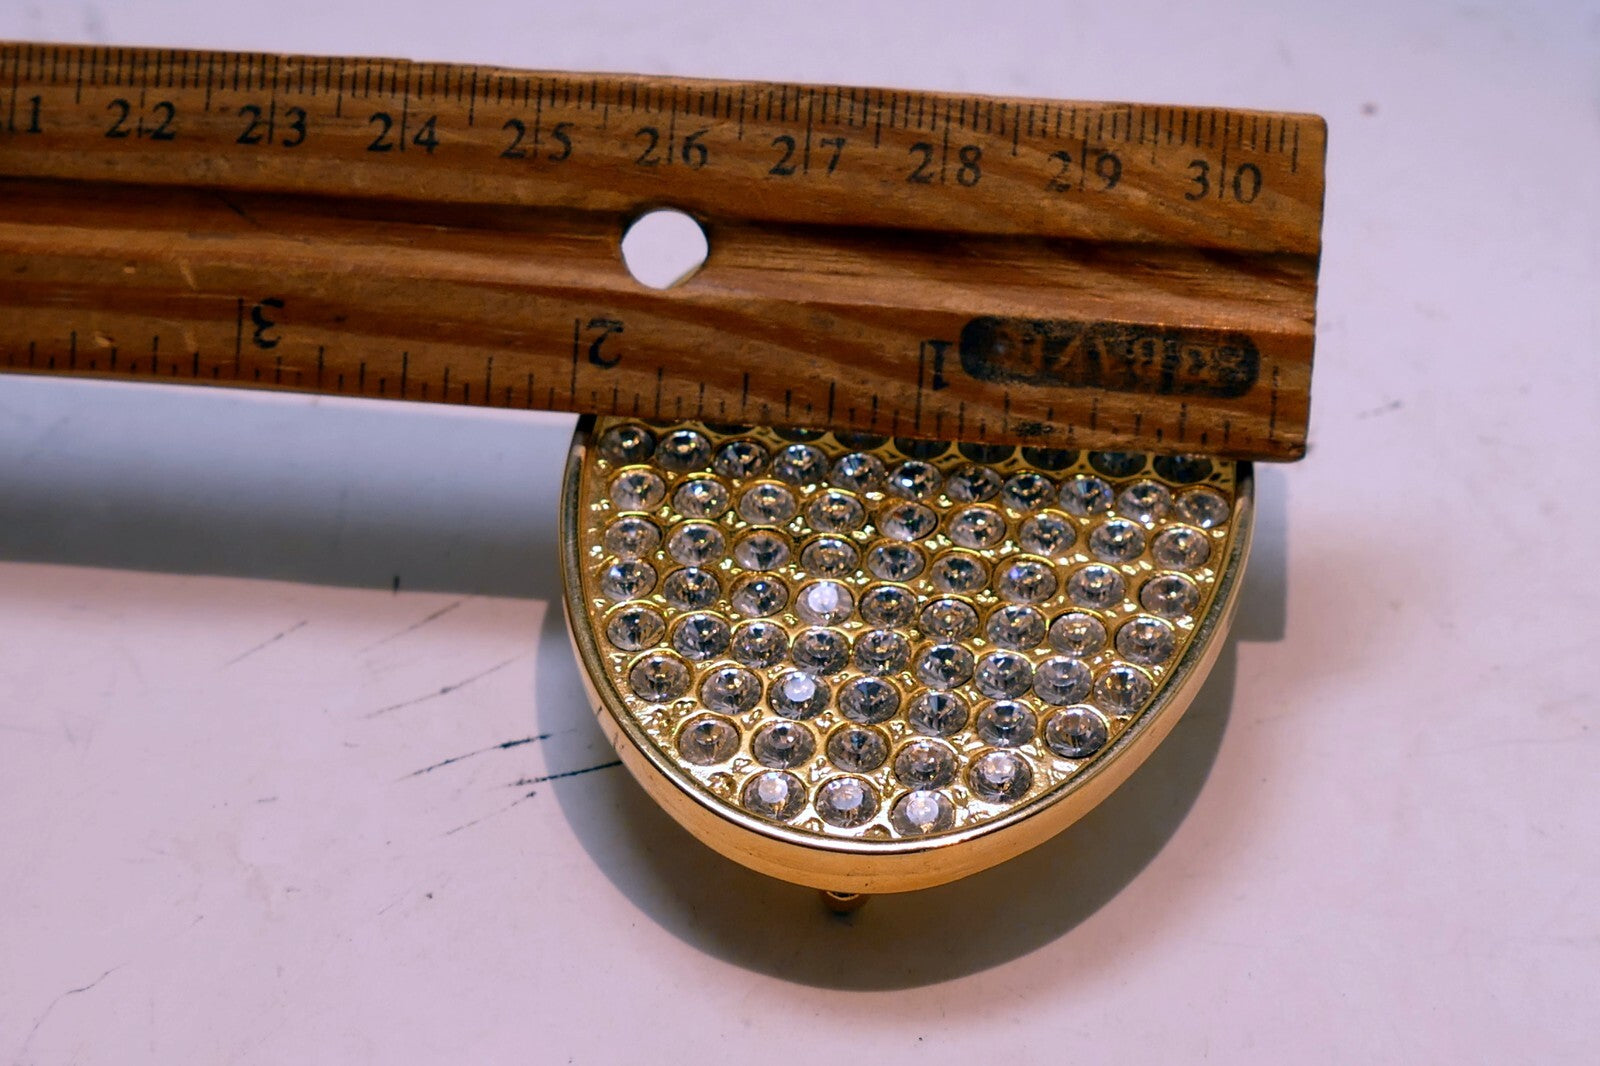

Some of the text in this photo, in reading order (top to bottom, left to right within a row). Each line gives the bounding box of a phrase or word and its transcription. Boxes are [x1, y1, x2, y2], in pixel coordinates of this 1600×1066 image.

[105, 98, 177, 140] 22
[236, 104, 307, 147] 23
[367, 111, 439, 154] 24
[501, 117, 575, 162] 25
[634, 125, 709, 169] 26
[768, 135, 847, 178] 27
[906, 142, 984, 187] 28
[1184, 159, 1262, 203] 30
[250, 297, 285, 349] 3
[586, 317, 624, 369] 2
[926, 339, 953, 391] 1
